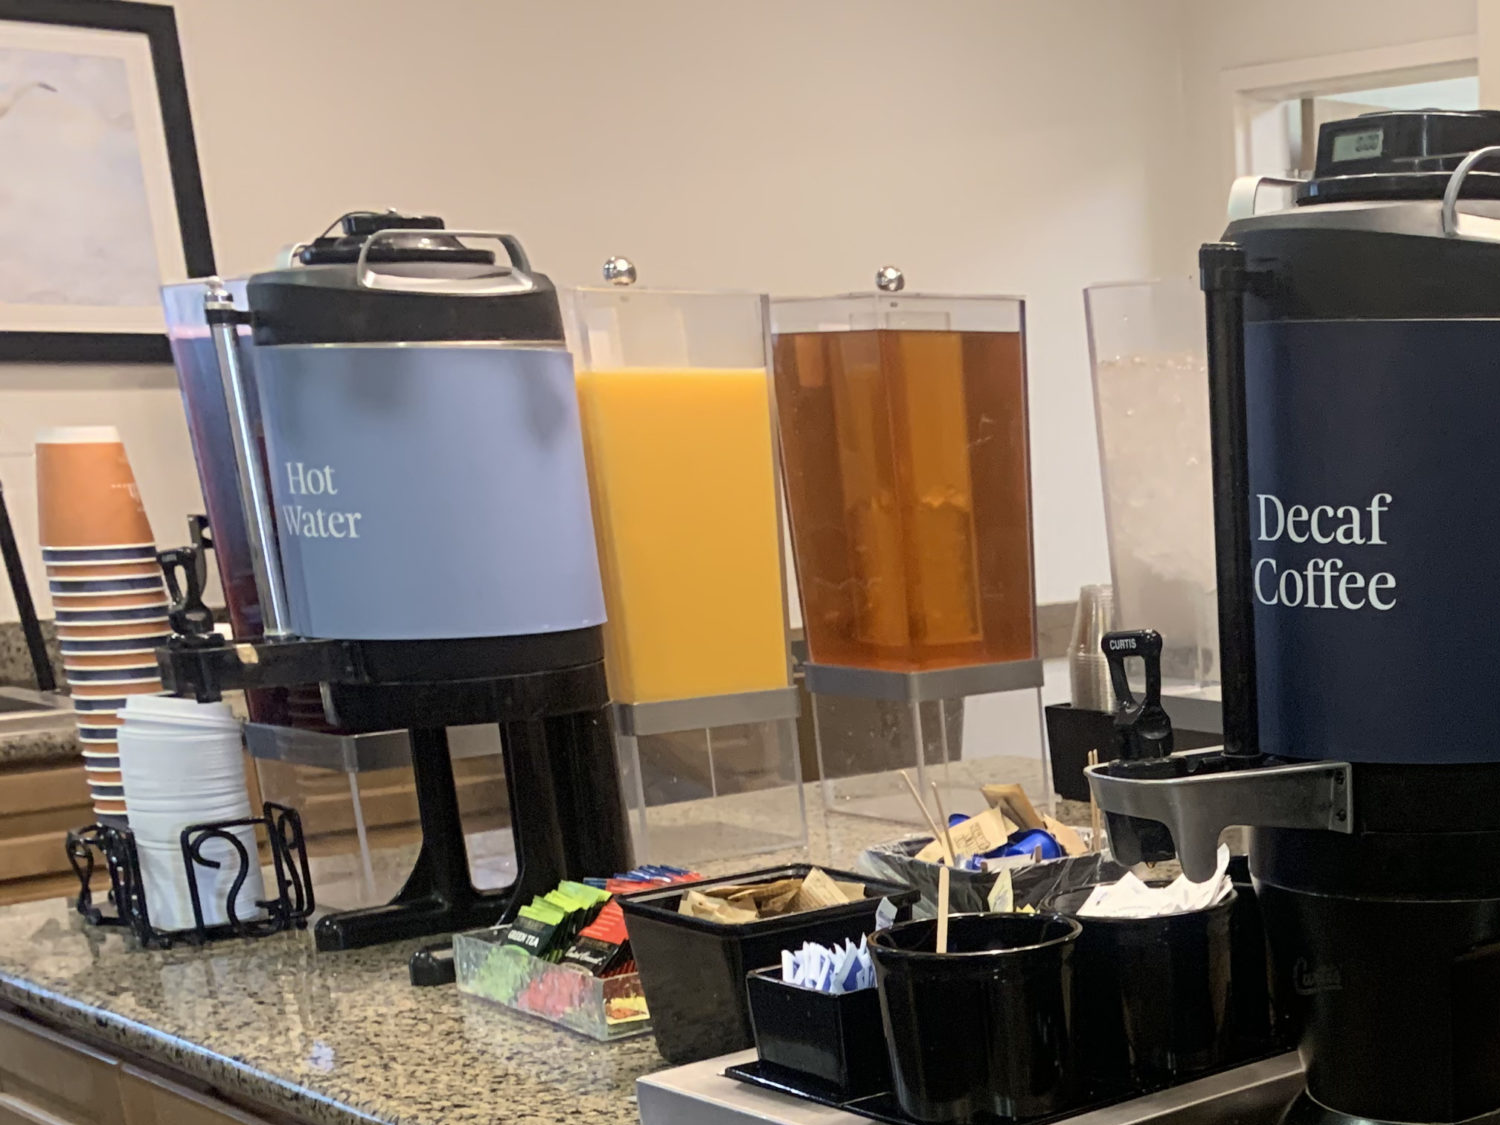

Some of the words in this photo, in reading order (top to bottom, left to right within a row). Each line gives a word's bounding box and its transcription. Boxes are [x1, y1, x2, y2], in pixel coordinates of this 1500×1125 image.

[285, 462, 338, 495] Hot
[282, 505, 362, 538] Water
[1256, 493, 1392, 545] Decaf
[1254, 558, 1397, 610] Coffee
[1110, 638, 1137, 650] CURTIS
[525, 934, 540, 948] TEA
